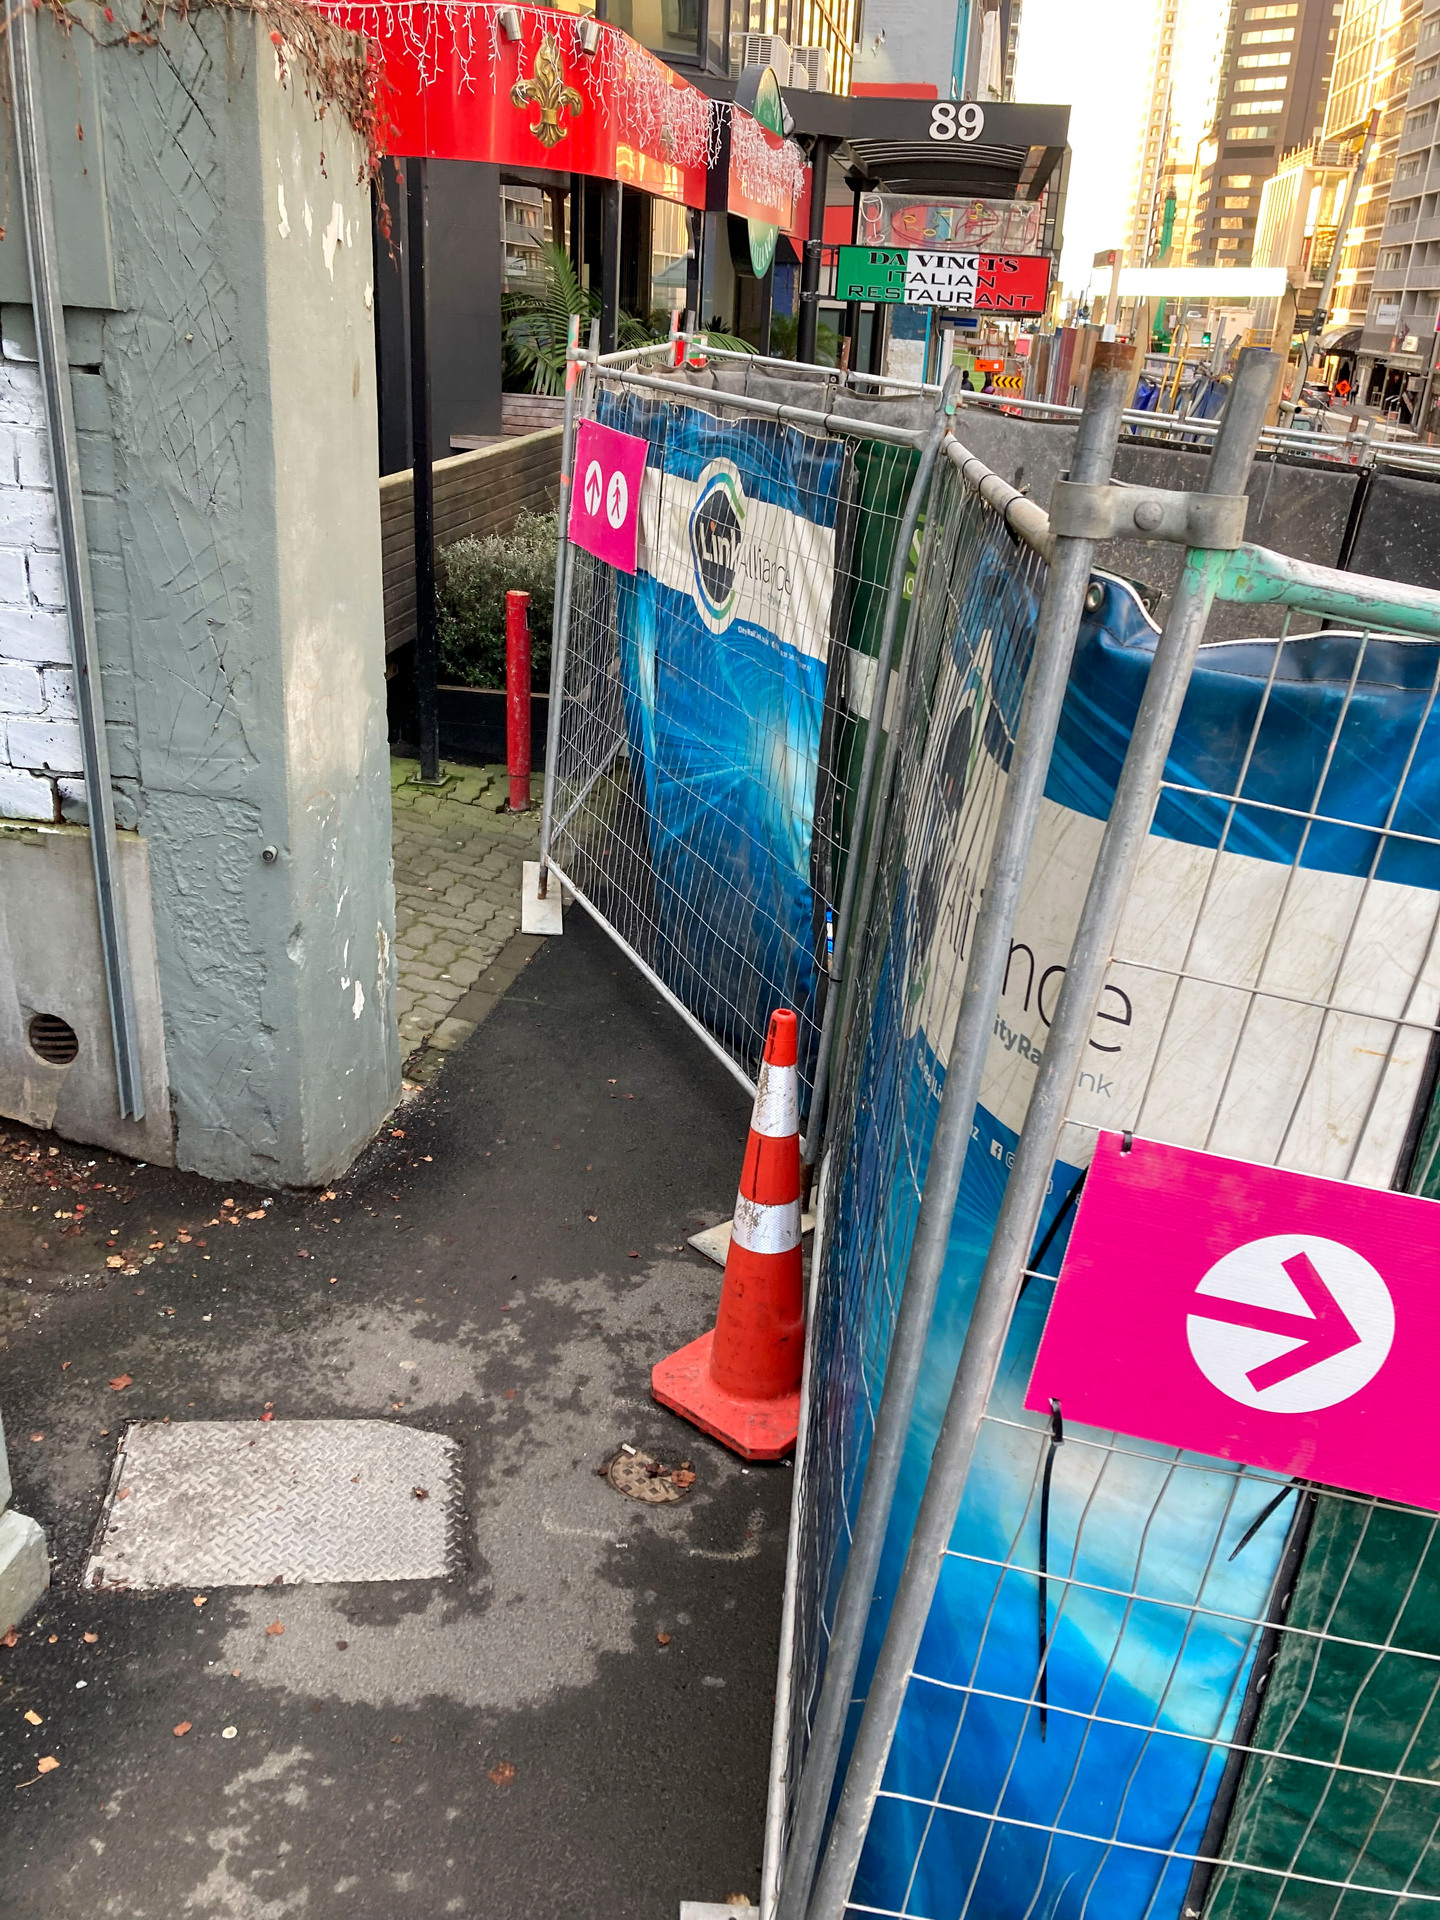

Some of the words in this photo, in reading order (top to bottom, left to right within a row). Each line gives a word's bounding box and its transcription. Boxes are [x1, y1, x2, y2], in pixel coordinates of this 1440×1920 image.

[929, 102, 984, 141] 89
[869, 252, 906, 266] DA
[916, 254, 1018, 273] VINCI'S
[887, 270, 995, 288] ITALIAN
[848, 285, 1033, 308] RESTAURANT
